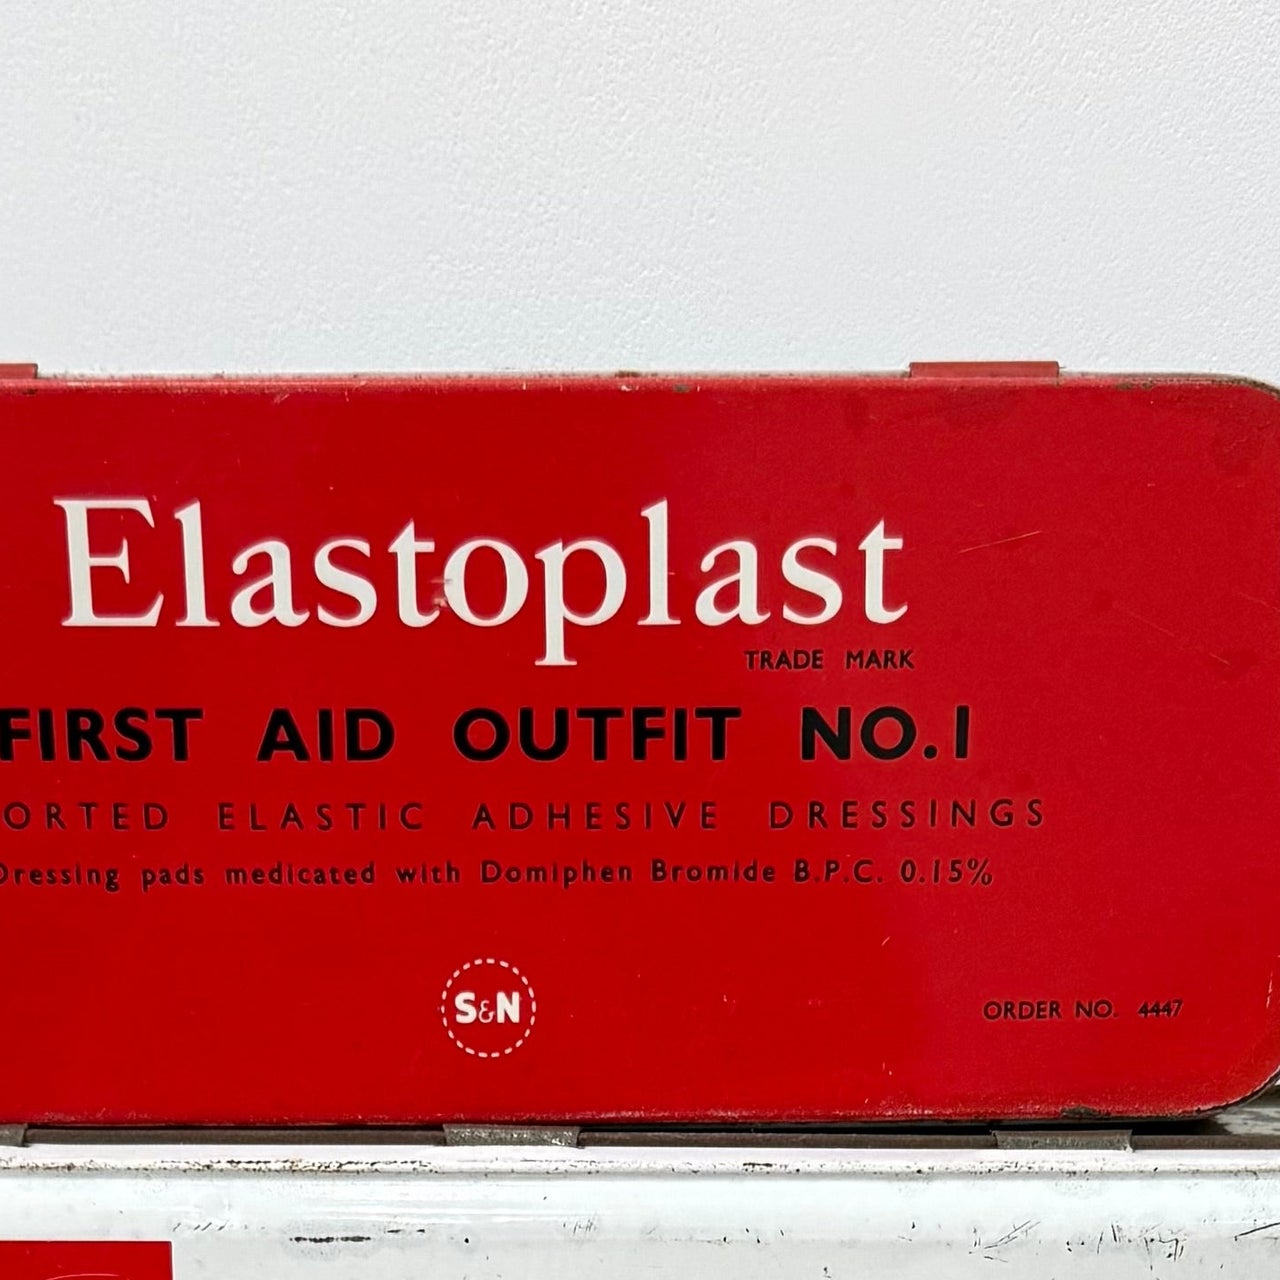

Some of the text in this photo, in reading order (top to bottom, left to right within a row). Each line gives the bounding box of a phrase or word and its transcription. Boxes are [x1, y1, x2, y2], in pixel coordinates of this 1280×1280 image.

[53, 495, 910, 667] Elastoplast
[744, 648, 915, 671] TRADE MARK
[256, 708, 395, 762] AID
[453, 706, 742, 762] OUTFIT
[219, 802, 424, 831] ELASTIC
[472, 802, 719, 831] ADHESIVE
[769, 798, 1045, 829] DRESSINGS
[141, 862, 205, 893] pads
[225, 861, 376, 886] medicated
[395, 861, 461, 885] with
[480, 860, 634, 889] Domiphen
[650, 859, 776, 884] Bromide
[793, 858, 883, 885] B.P.C.
[899, 856, 994, 887] 0.15%
[454, 990, 521, 1025] S&N
[983, 1000, 1062, 1020] ORDER
[1074, 999, 1119, 1019] NO.
